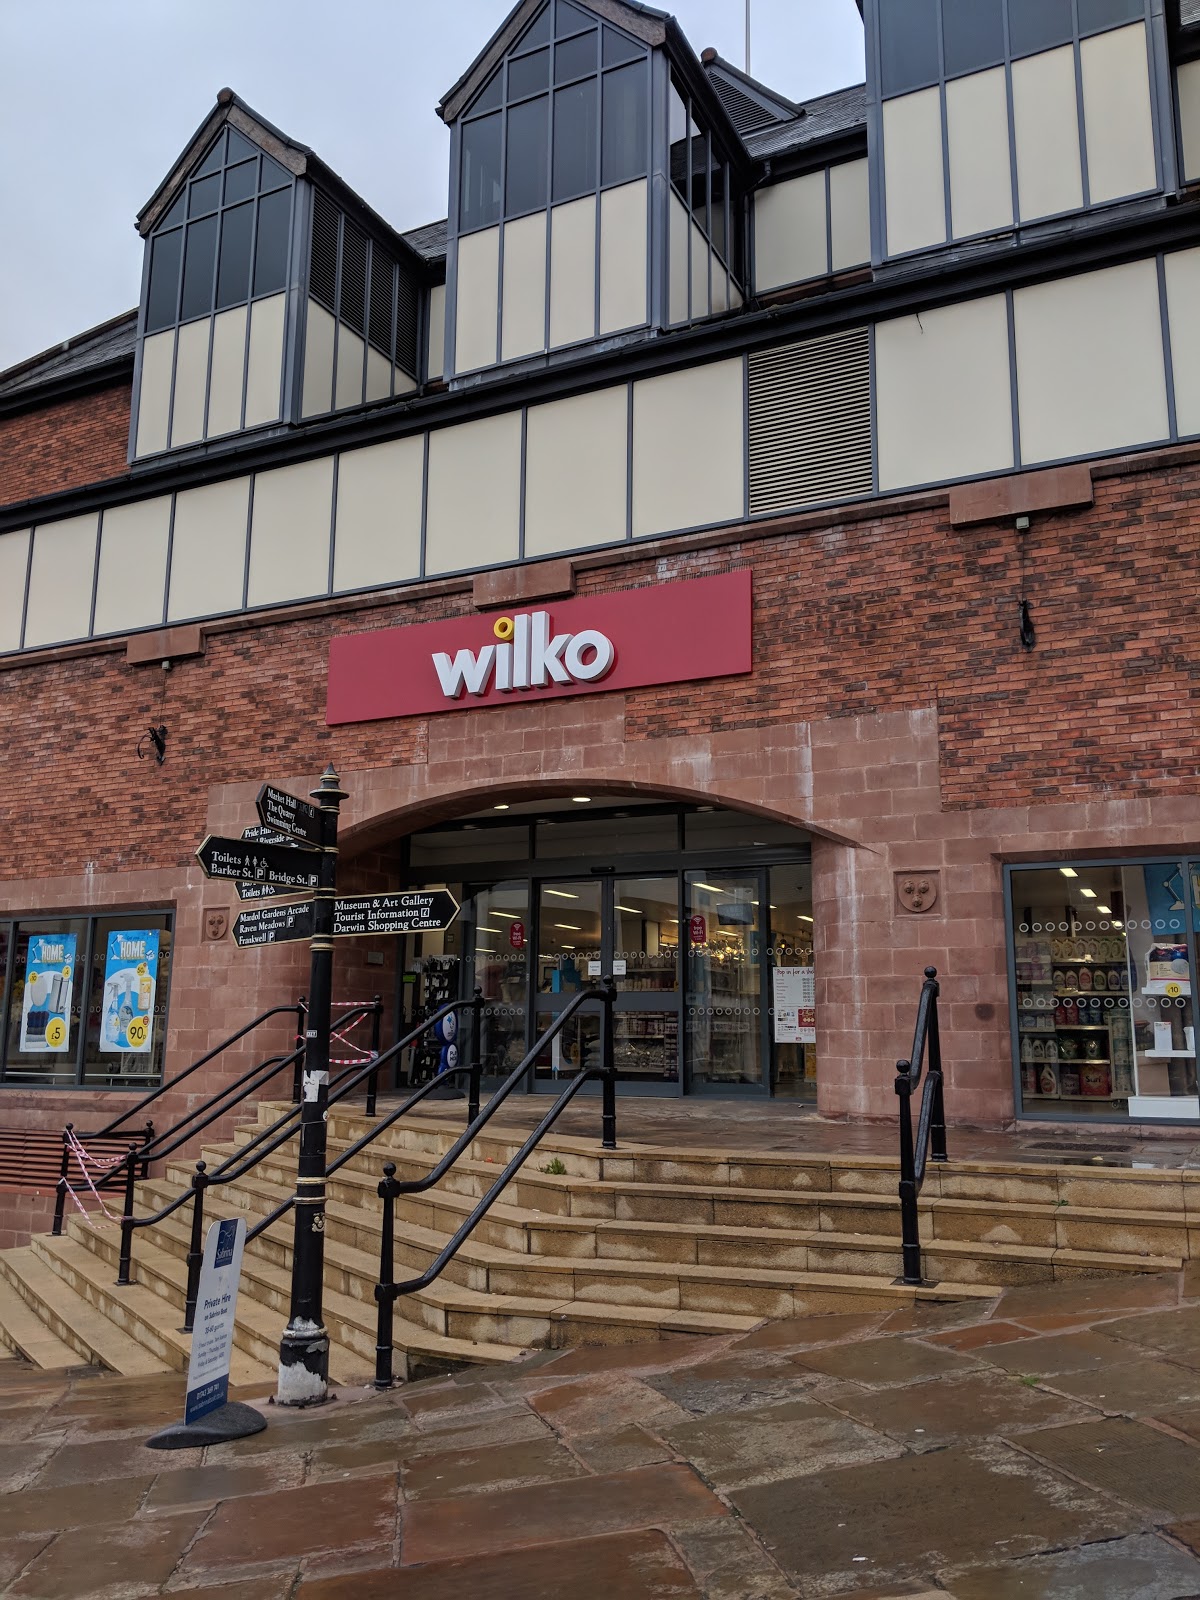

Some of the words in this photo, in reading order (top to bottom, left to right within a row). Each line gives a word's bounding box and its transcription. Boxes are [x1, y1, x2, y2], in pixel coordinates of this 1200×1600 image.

[431, 610, 616, 699] wilko
[267, 788, 285, 804] Market
[285, 795, 297, 809] Hall
[267, 800, 278, 813] The
[278, 805, 296, 822] Quarry
[266, 812, 291, 833] Swimming
[291, 822, 307, 836] Centre
[244, 828, 259, 838] Pride
[211, 850, 242, 865] Toilets
[211, 863, 241, 876] Barker
[242, 867, 254, 878] St.
[269, 870, 296, 885] Bridge
[296, 874, 308, 885] St.
[242, 888, 261, 898] Toilets
[334, 900, 371, 911] Museum
[372, 899, 380, 908] &
[382, 897, 399, 908] Art
[401, 894, 434, 907] Gallery
[240, 911, 261, 922] Mardol
[261, 908, 286, 919] Gardens
[287, 904, 310, 916] Arcade
[333, 911, 365, 922] Tourist
[367, 908, 419, 920] Information
[239, 924, 257, 934] Raven
[258, 920, 286, 931] Meadows
[333, 922, 365, 933] Darwin
[367, 920, 409, 932] Shopping
[411, 917, 441, 928] Centre
[239, 932, 267, 945] Frankwell
[41, 944, 64, 963] HOME
[120, 941, 146, 960] HOME
[51, 1027, 61, 1040] £5
[130, 1026, 147, 1040] 90p
[1085, 1075, 1102, 1083] Surf
[216, 1247, 233, 1260] Sabrina
[204, 1297, 221, 1310] Private
[221, 1293, 231, 1303] Hire
